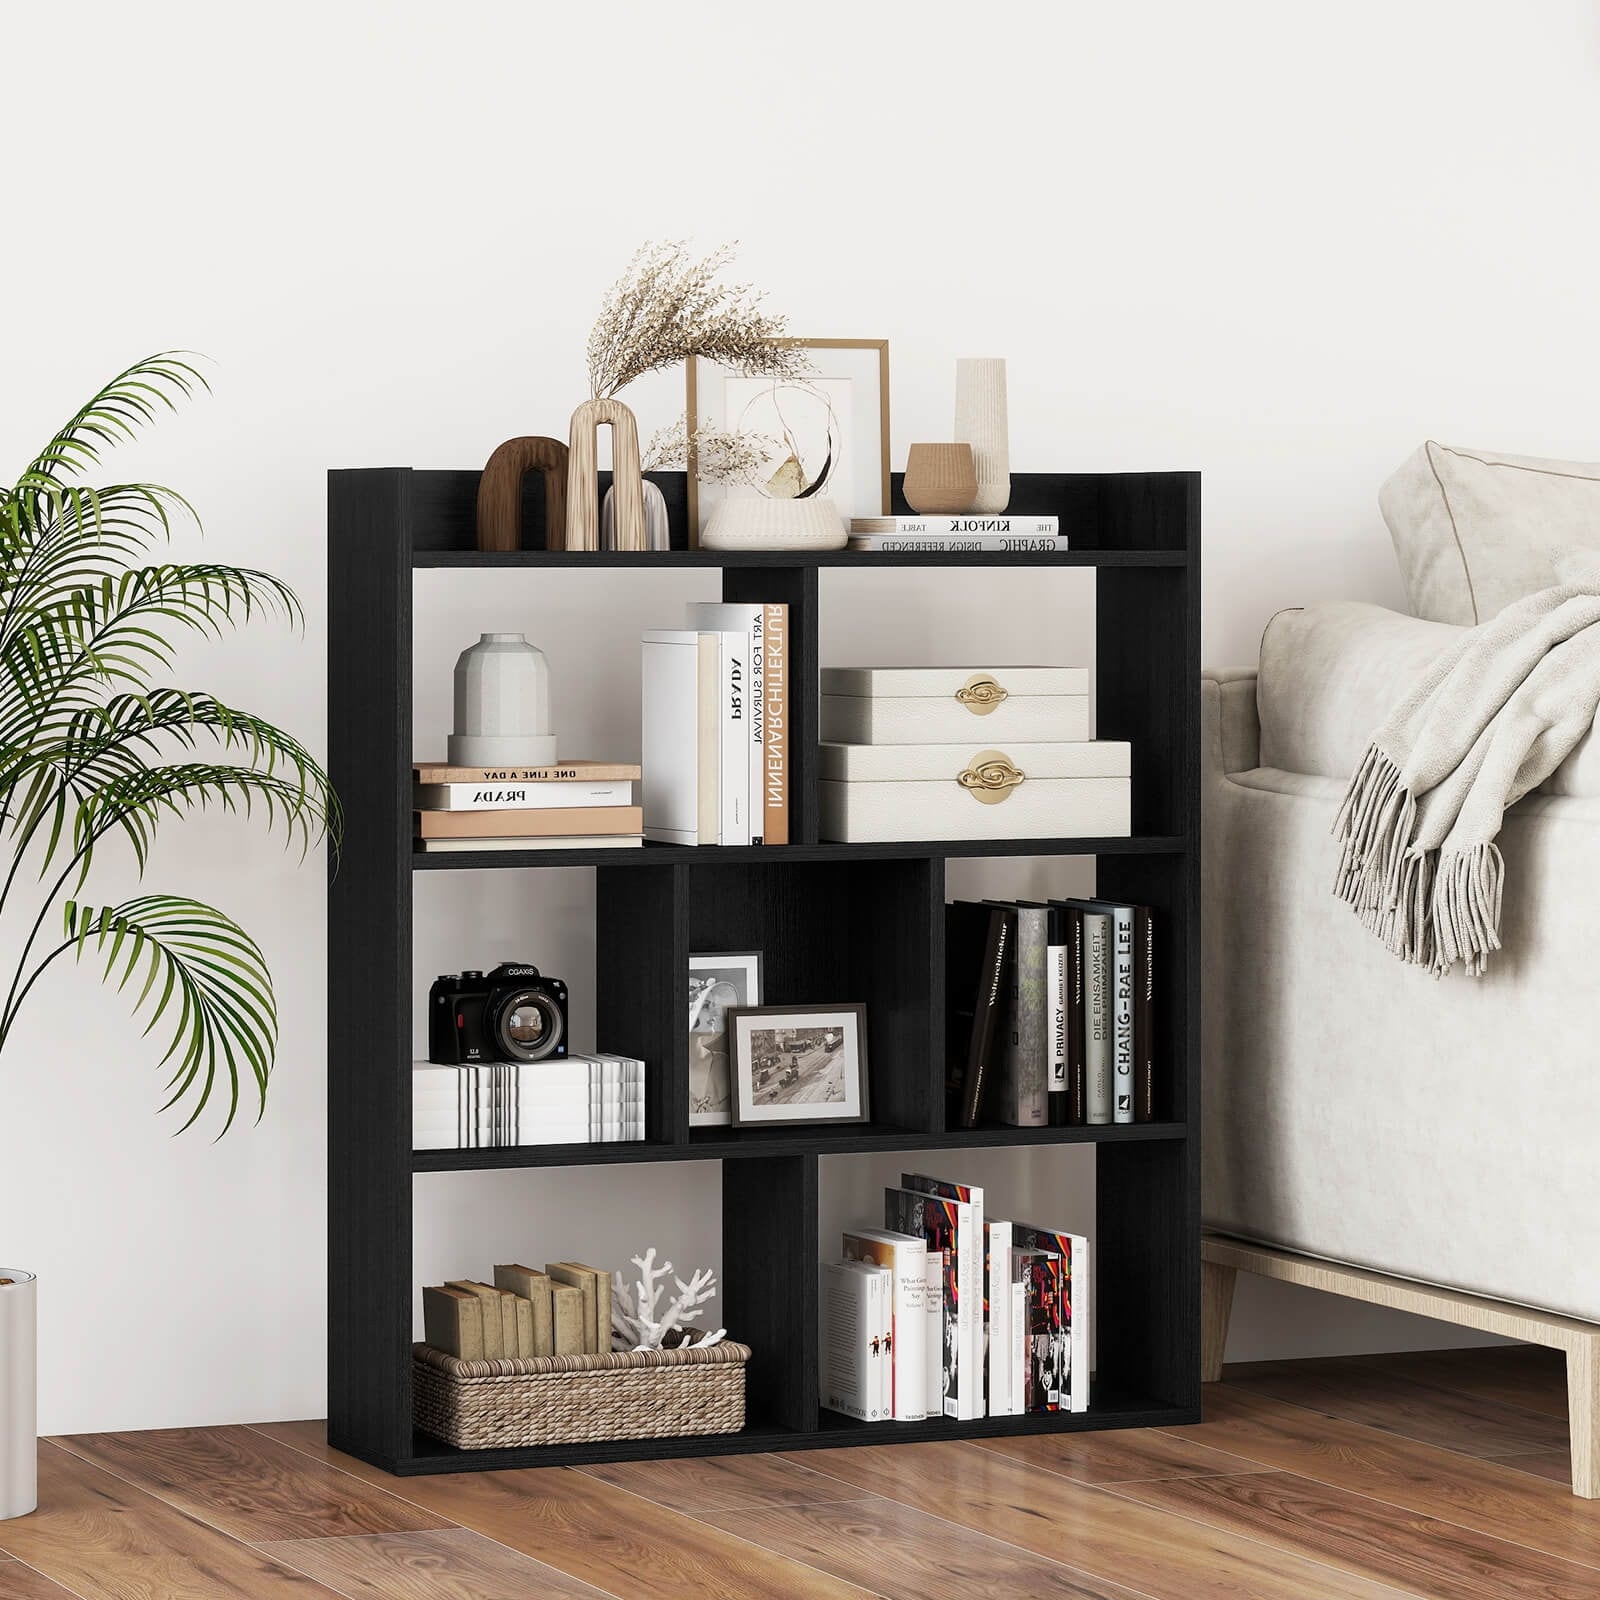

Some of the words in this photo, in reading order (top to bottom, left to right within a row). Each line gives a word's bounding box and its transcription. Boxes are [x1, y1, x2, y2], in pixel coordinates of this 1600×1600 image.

[1118, 921, 1131, 955] LEE
[1092, 933, 1101, 1015] EINSAMKEIT
[1055, 1008, 1065, 1057] PRIVACY
[1093, 1017, 1101, 1041] DIE
[1118, 964, 1131, 1075] CHANG-RAE
